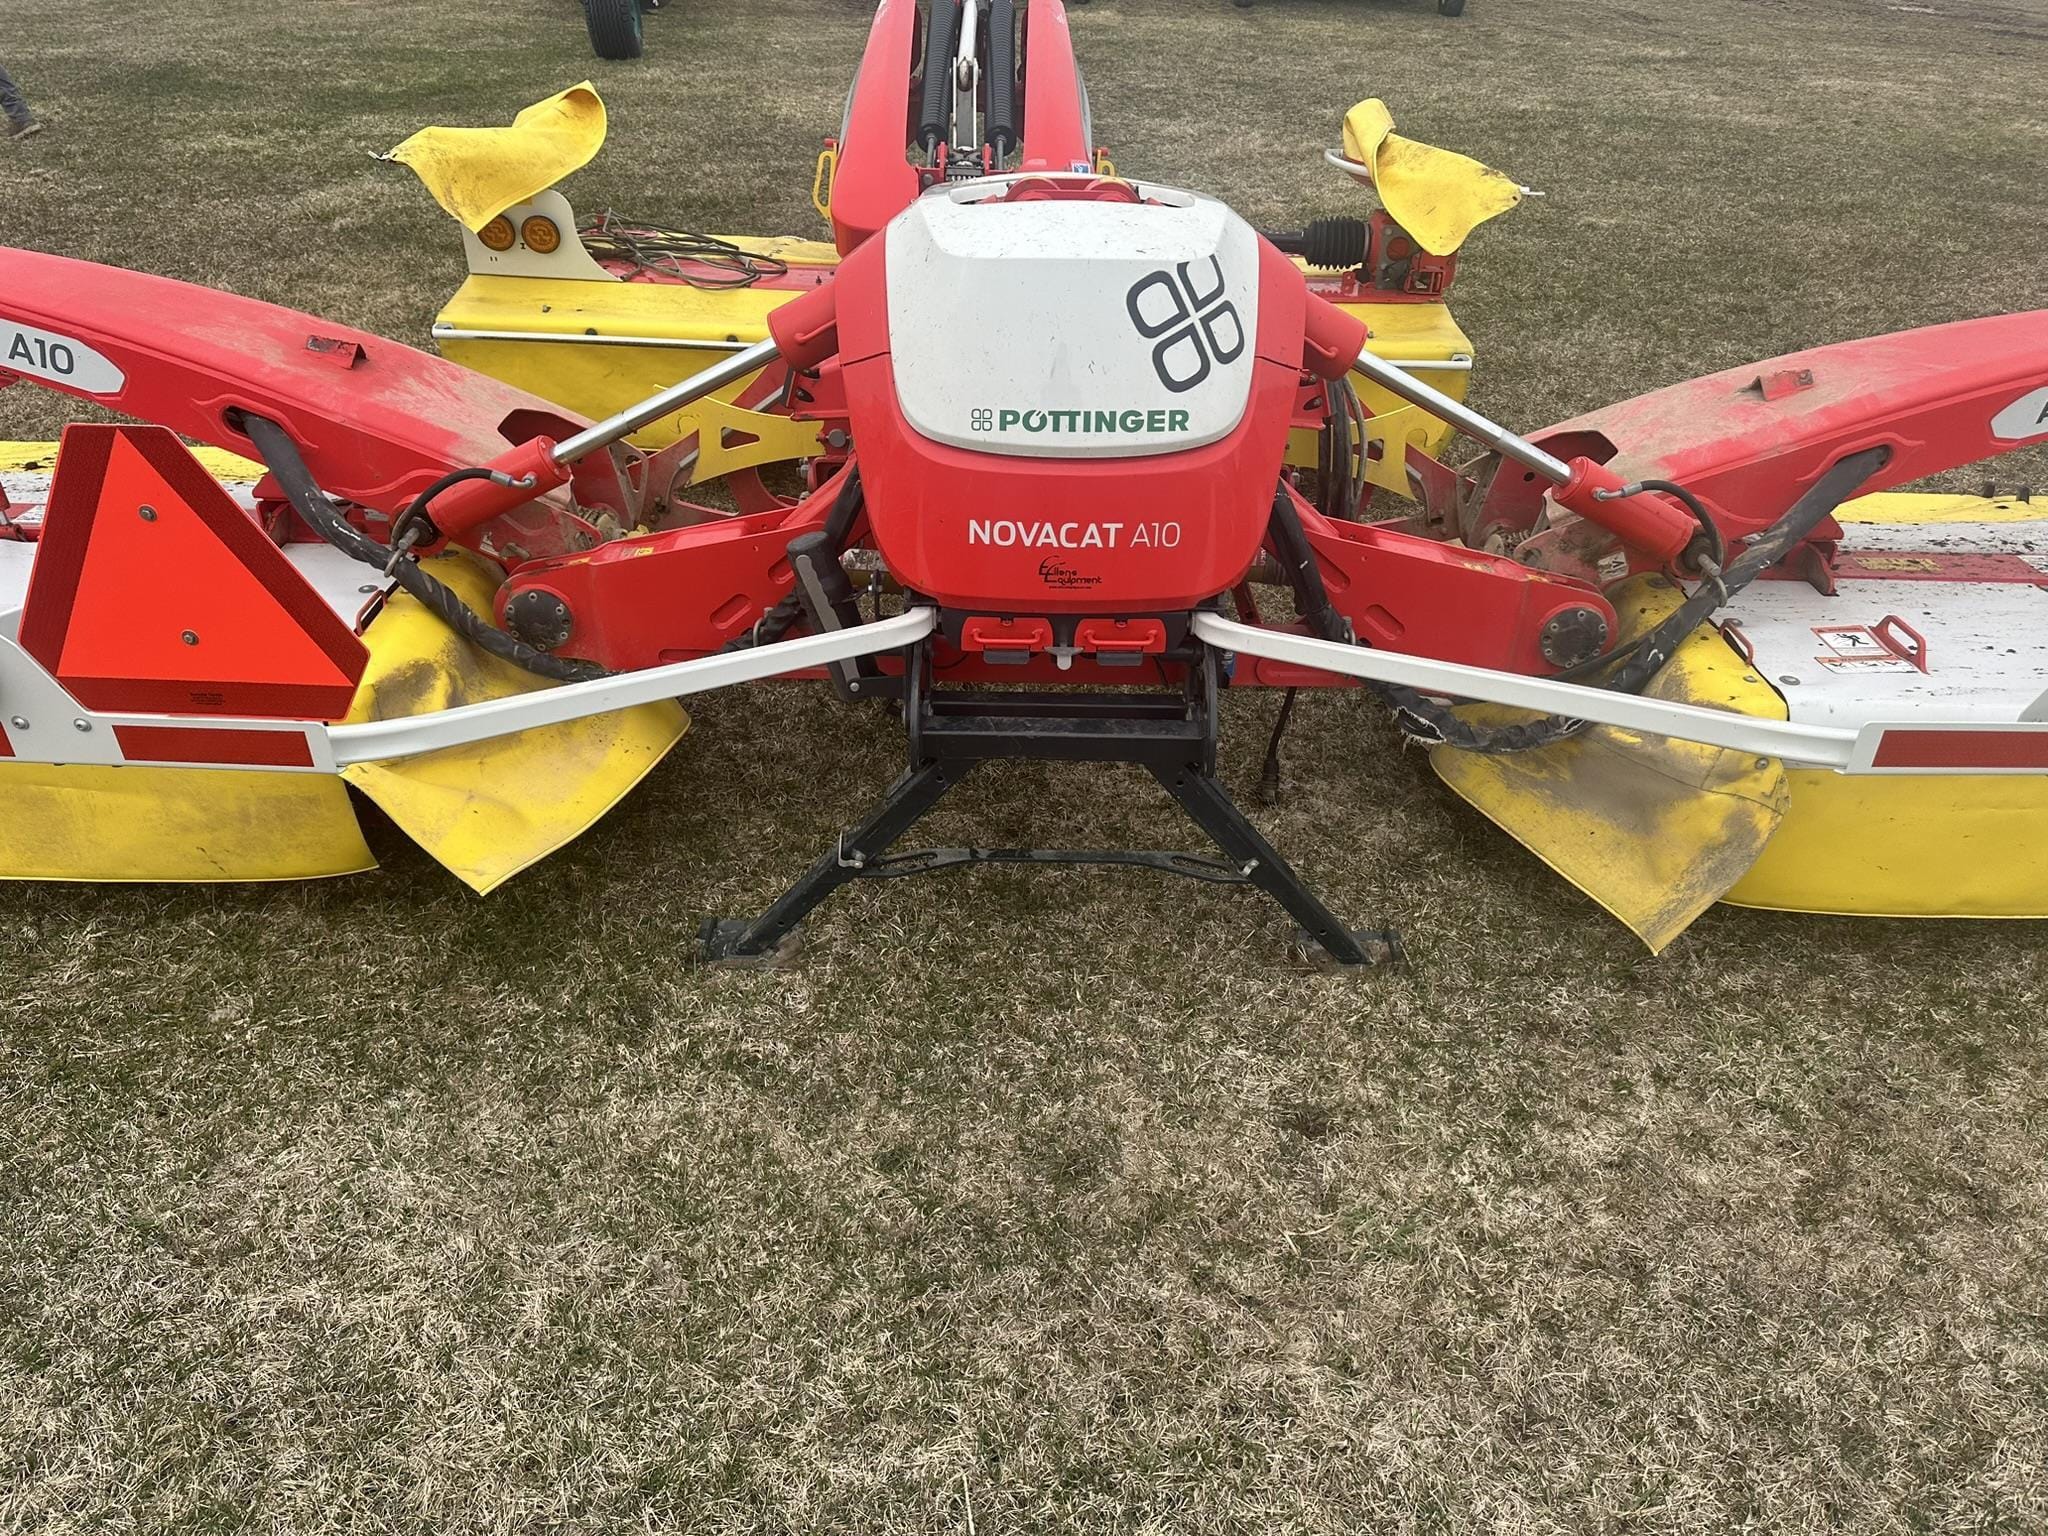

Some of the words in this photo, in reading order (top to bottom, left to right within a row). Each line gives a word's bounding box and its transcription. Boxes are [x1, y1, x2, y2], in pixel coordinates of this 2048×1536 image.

[8, 332, 75, 375] A10
[999, 409, 1190, 433] PÖTTINGER
[968, 519, 1124, 549] NOVACAT
[1129, 521, 1182, 549] A10
